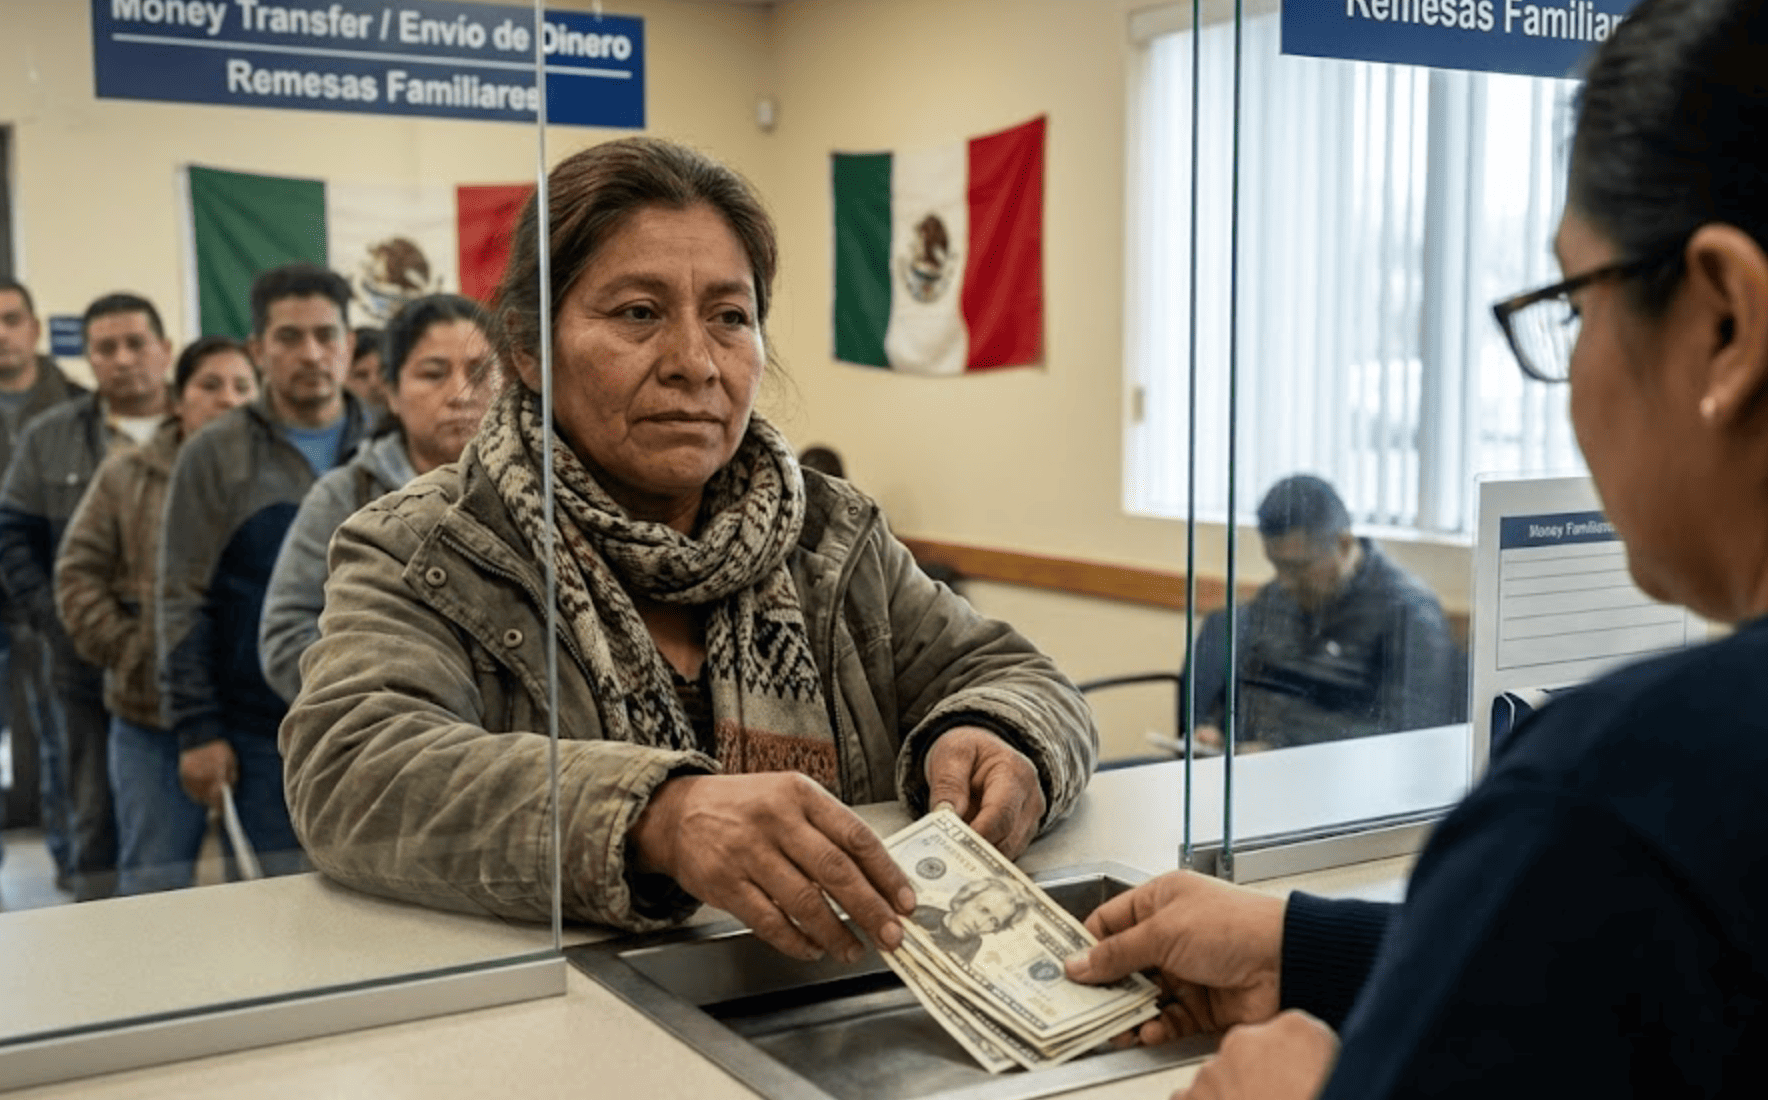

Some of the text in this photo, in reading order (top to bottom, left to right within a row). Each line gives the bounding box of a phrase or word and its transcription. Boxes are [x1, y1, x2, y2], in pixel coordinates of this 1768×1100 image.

[110, 0, 632, 60] Money Transfer / Envío de Dinero
[227, 58, 541, 111] Remesas Familiares
